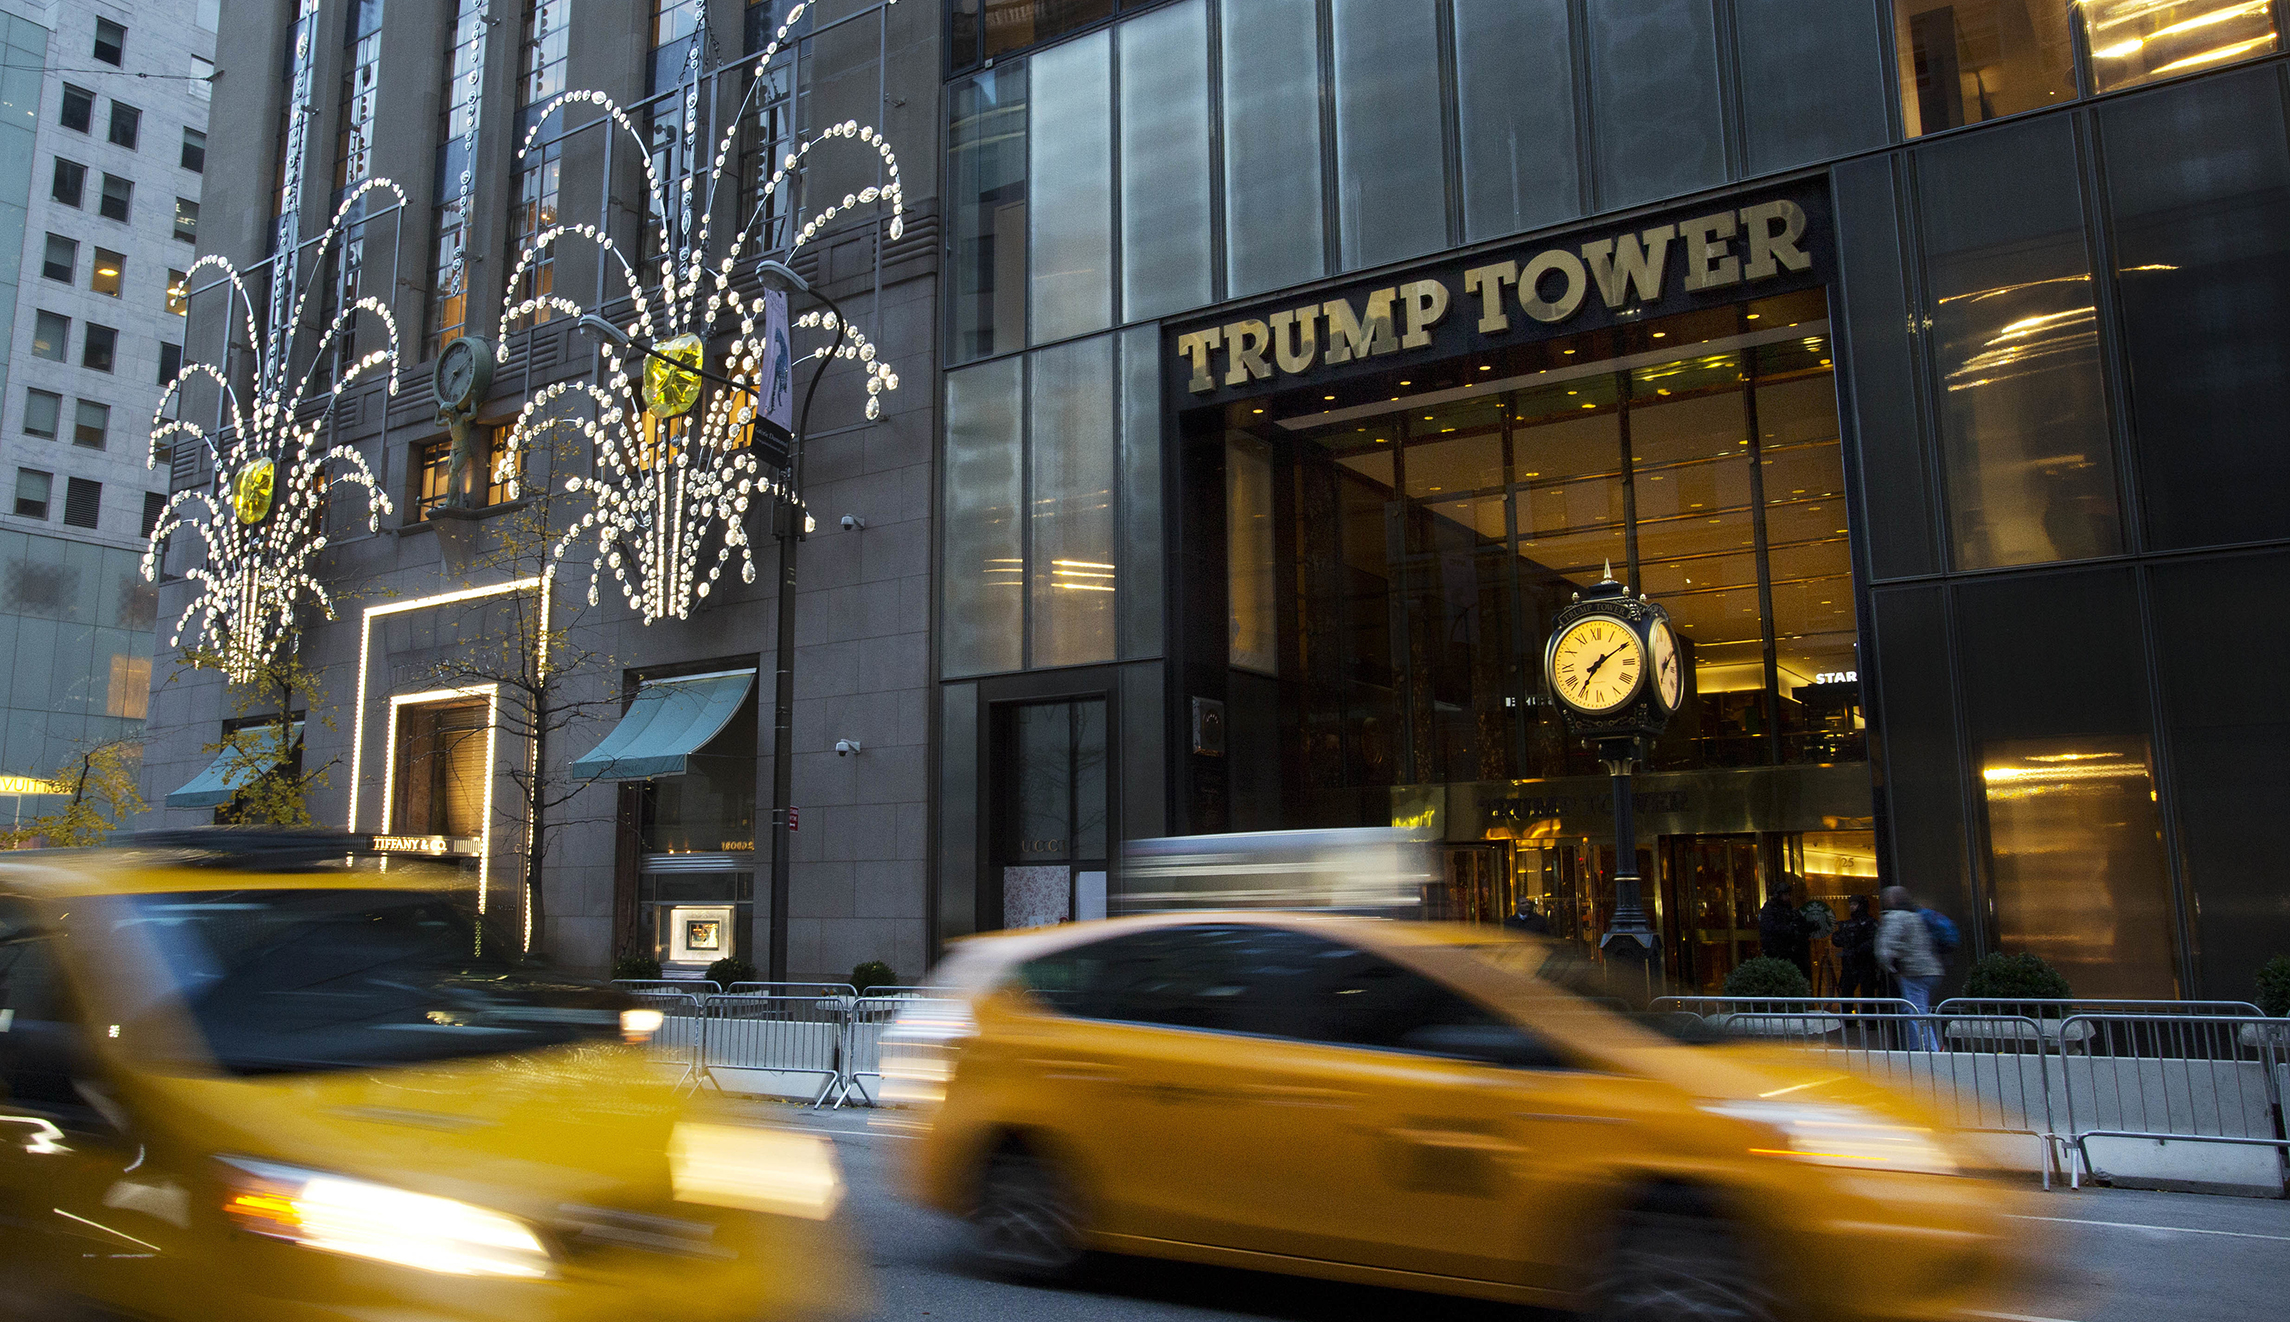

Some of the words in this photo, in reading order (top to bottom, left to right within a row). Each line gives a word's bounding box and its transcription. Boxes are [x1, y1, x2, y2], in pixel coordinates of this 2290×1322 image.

[1178, 279, 1450, 393] TRUMP
[1464, 199, 1812, 334] TOWER
[1564, 605, 1593, 621] TRUMP
[1595, 603, 1627, 616] TOWER
[373, 838, 420, 851] TIFFANY
[420, 839, 429, 850] &
